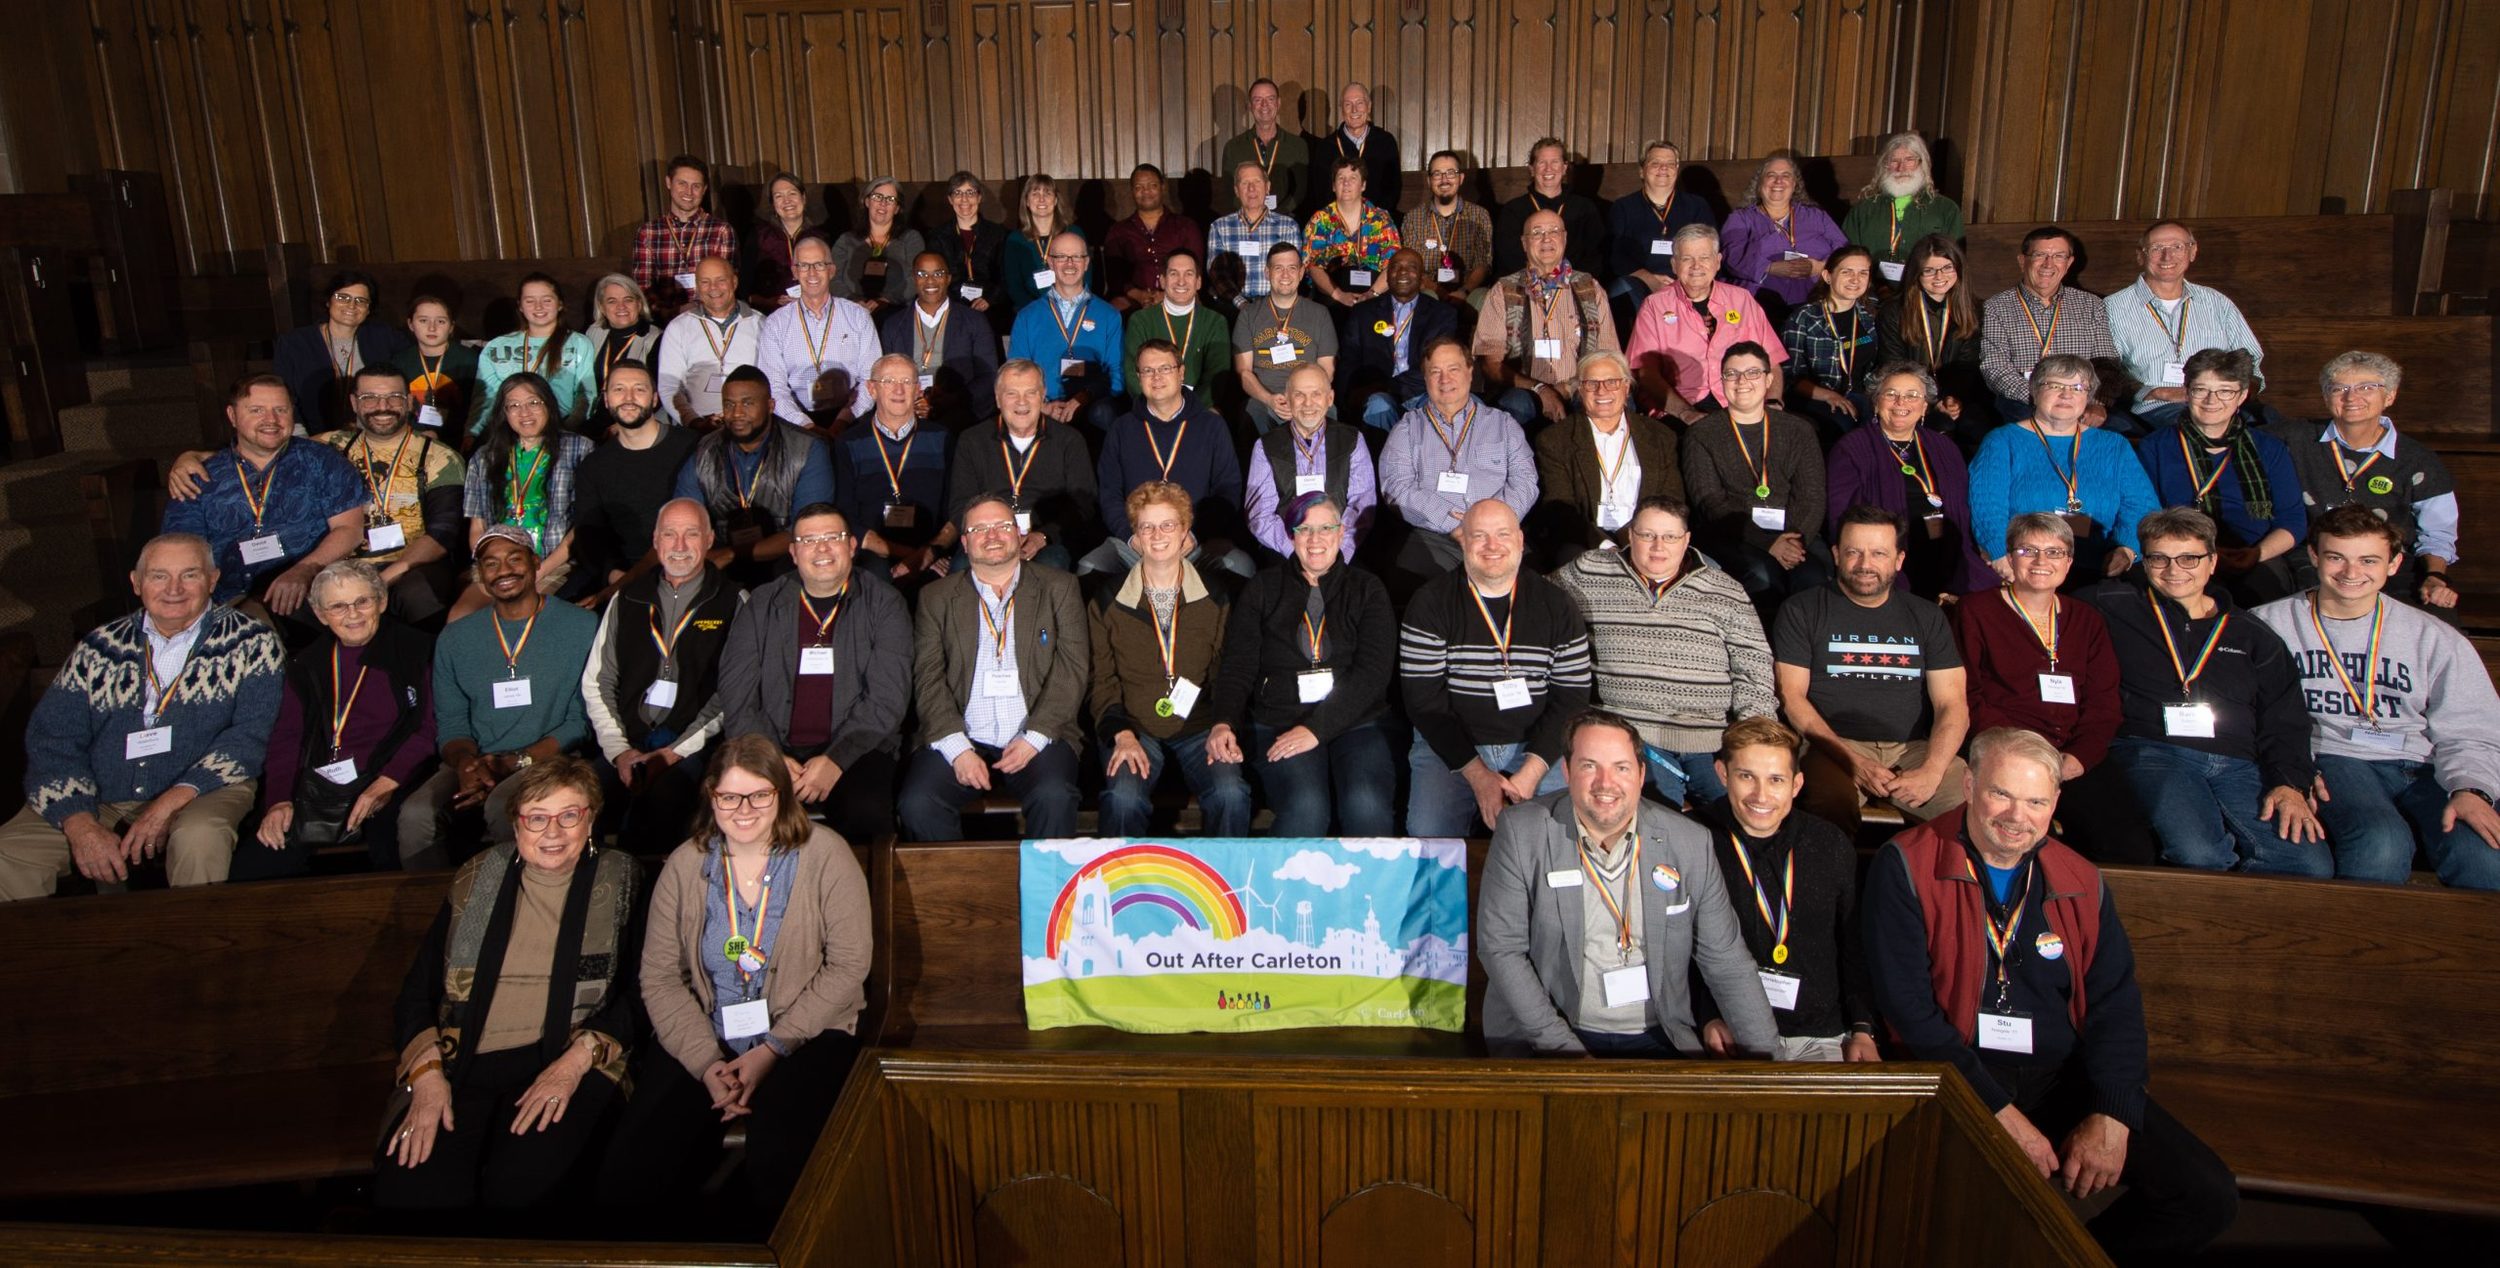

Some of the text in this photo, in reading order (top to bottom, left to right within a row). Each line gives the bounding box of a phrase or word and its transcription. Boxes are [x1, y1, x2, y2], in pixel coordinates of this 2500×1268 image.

[1253, 327, 1313, 347] CARTON
[1831, 634, 1914, 644] URBAN
[2294, 650, 2334, 679] AIR
[1830, 672, 1914, 680] ATHLETE
[728, 941, 745, 951] SHE
[1146, 952, 1342, 969] Out After Carleton
[1378, 1007, 1425, 1019] Carleton
[1997, 1019, 2012, 1027] Stu
